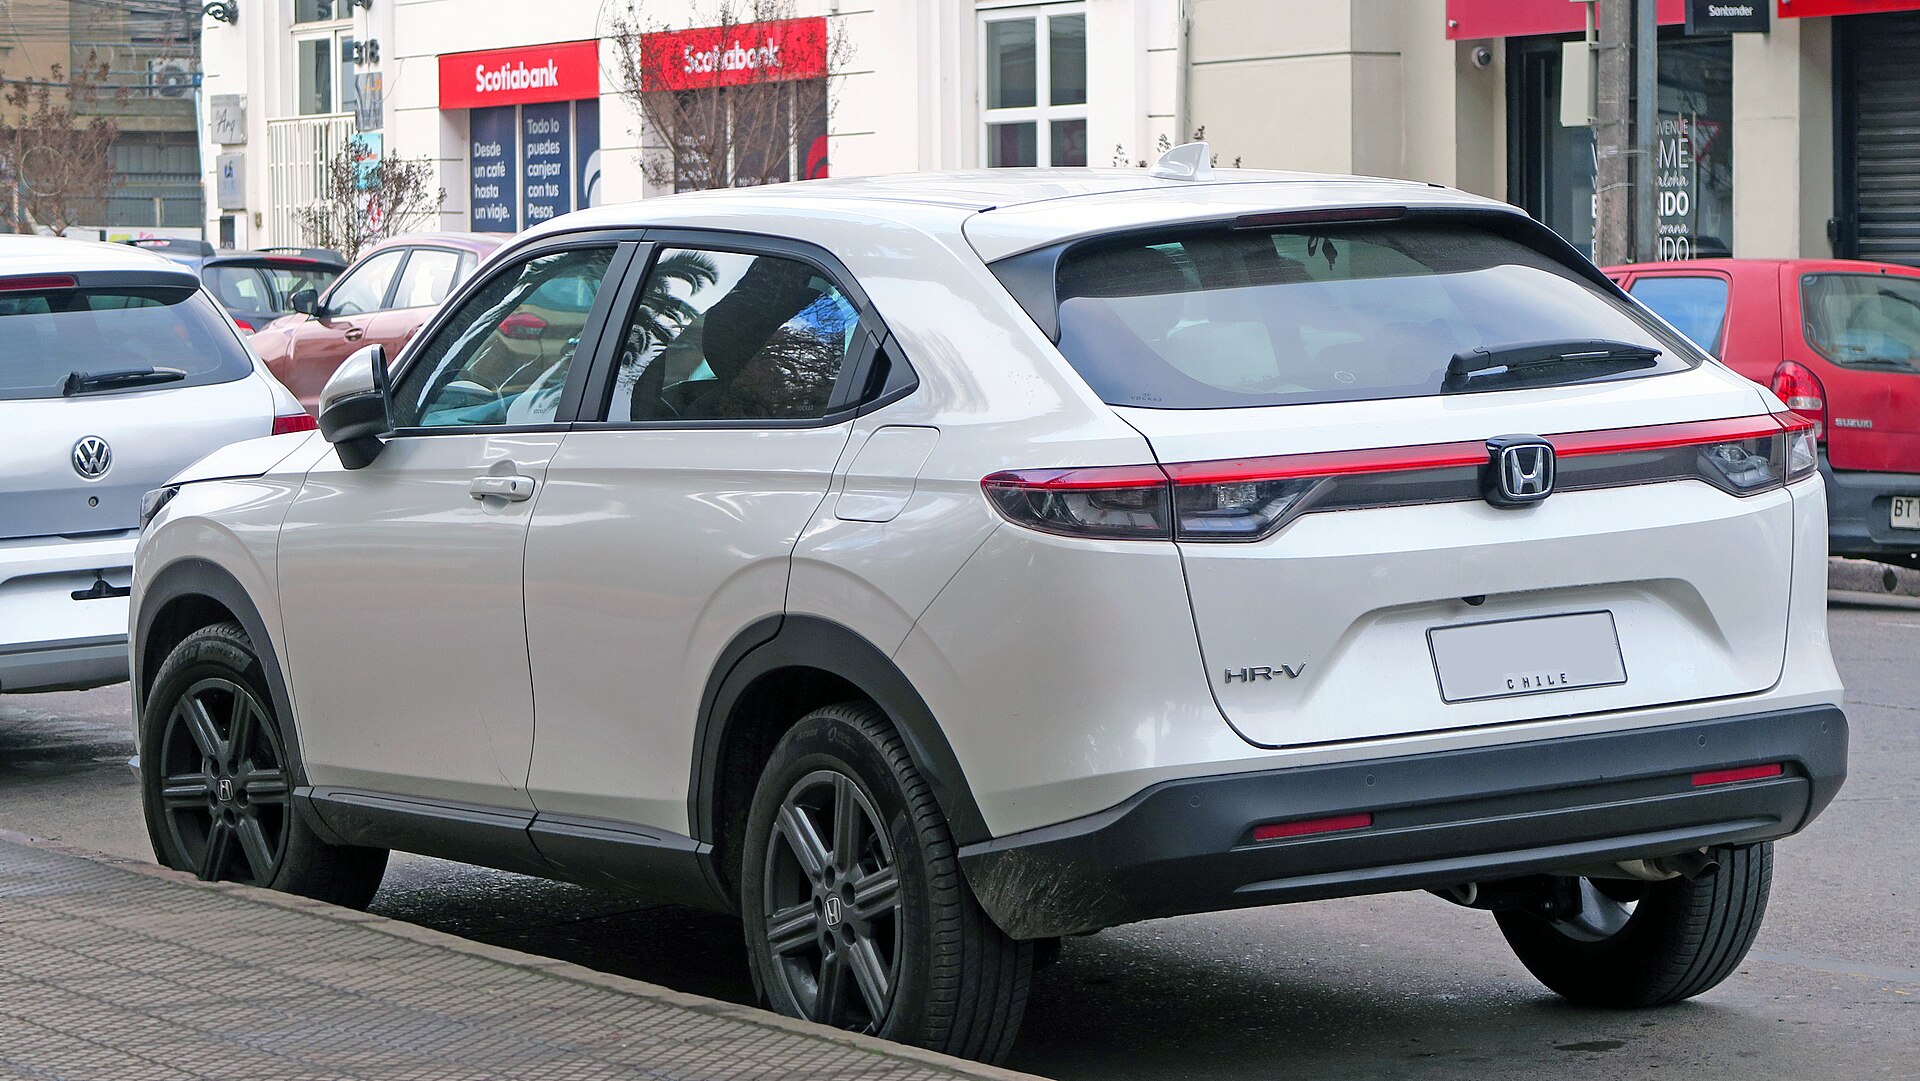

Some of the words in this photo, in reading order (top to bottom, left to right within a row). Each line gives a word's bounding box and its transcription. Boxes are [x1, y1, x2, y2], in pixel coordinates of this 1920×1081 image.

[1708, 4, 1753, 17] Santander
[353, 39, 380, 65] 318
[684, 37, 780, 74] Scotabank
[476, 58, 558, 93] Scotiabank
[527, 118, 550, 135] Todo
[550, 118, 560, 133] lo
[474, 141, 502, 157] Desde
[527, 139, 560, 159] puedes
[474, 165, 486, 178] un
[486, 160, 506, 178] café
[527, 160, 562, 180] canjear
[474, 183, 499, 199] hasta
[528, 184, 545, 198] con
[545, 182, 560, 197] tus
[528, 203, 554, 219] Pesos
[1658, 190, 1690, 217] IDO
[475, 206, 486, 220] un
[486, 203, 511, 223] viaje.
[1835, 417, 1873, 429] SUZUKI
[1895, 499, 1920, 518] BT
[1225, 661, 1306, 684] HR-V
[1507, 673, 1568, 690] CHILE
